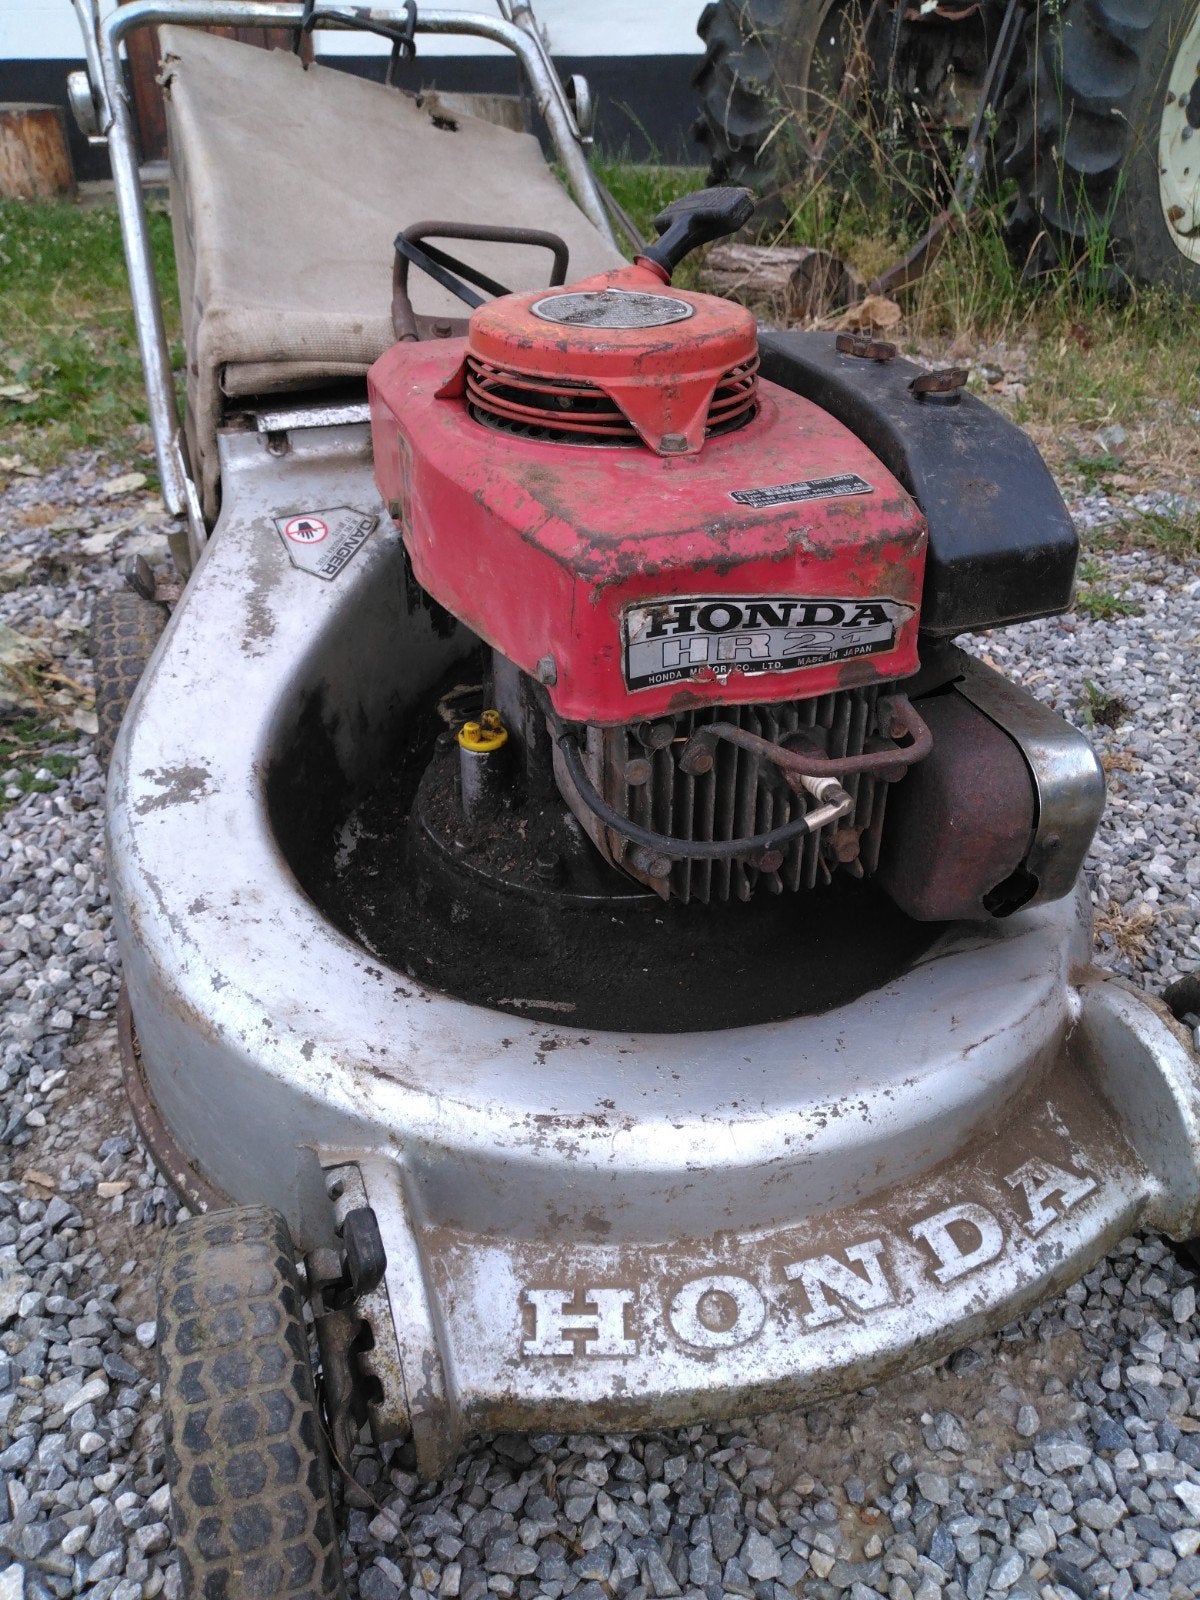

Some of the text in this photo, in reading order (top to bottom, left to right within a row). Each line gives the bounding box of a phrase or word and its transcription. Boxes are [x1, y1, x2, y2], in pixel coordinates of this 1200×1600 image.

[322, 519, 372, 575] DANGER
[646, 603, 892, 638] HONDA
[648, 670, 682, 684] HONDA
[689, 665, 727, 676] MOOR
[762, 661, 784, 670] LTD.
[829, 651, 838, 660] IN
[843, 645, 872, 657] JAPAN
[523, 1155, 1097, 1357] HONDA
